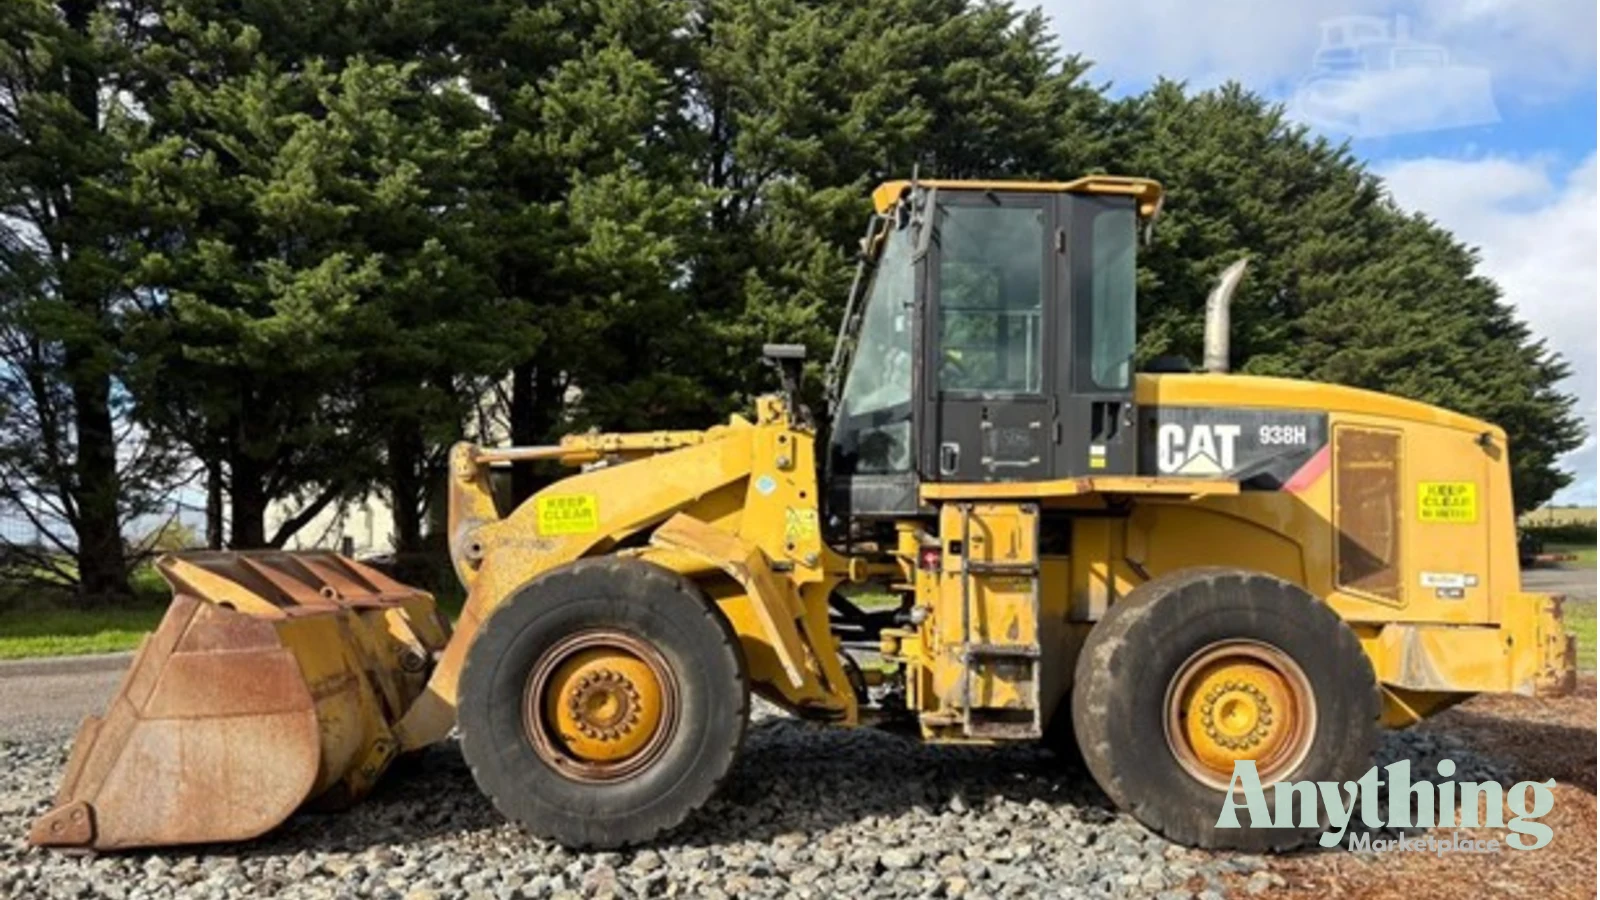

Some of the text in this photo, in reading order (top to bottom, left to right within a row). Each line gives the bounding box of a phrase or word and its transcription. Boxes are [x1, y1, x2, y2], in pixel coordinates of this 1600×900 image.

[1259, 425, 1306, 444] 938H
[1158, 423, 1241, 473] CAT
[1427, 485, 1468, 496] KEEP
[547, 496, 587, 508] KEEP
[1423, 496, 1472, 507] CLEAR
[544, 508, 592, 520] CLEAR
